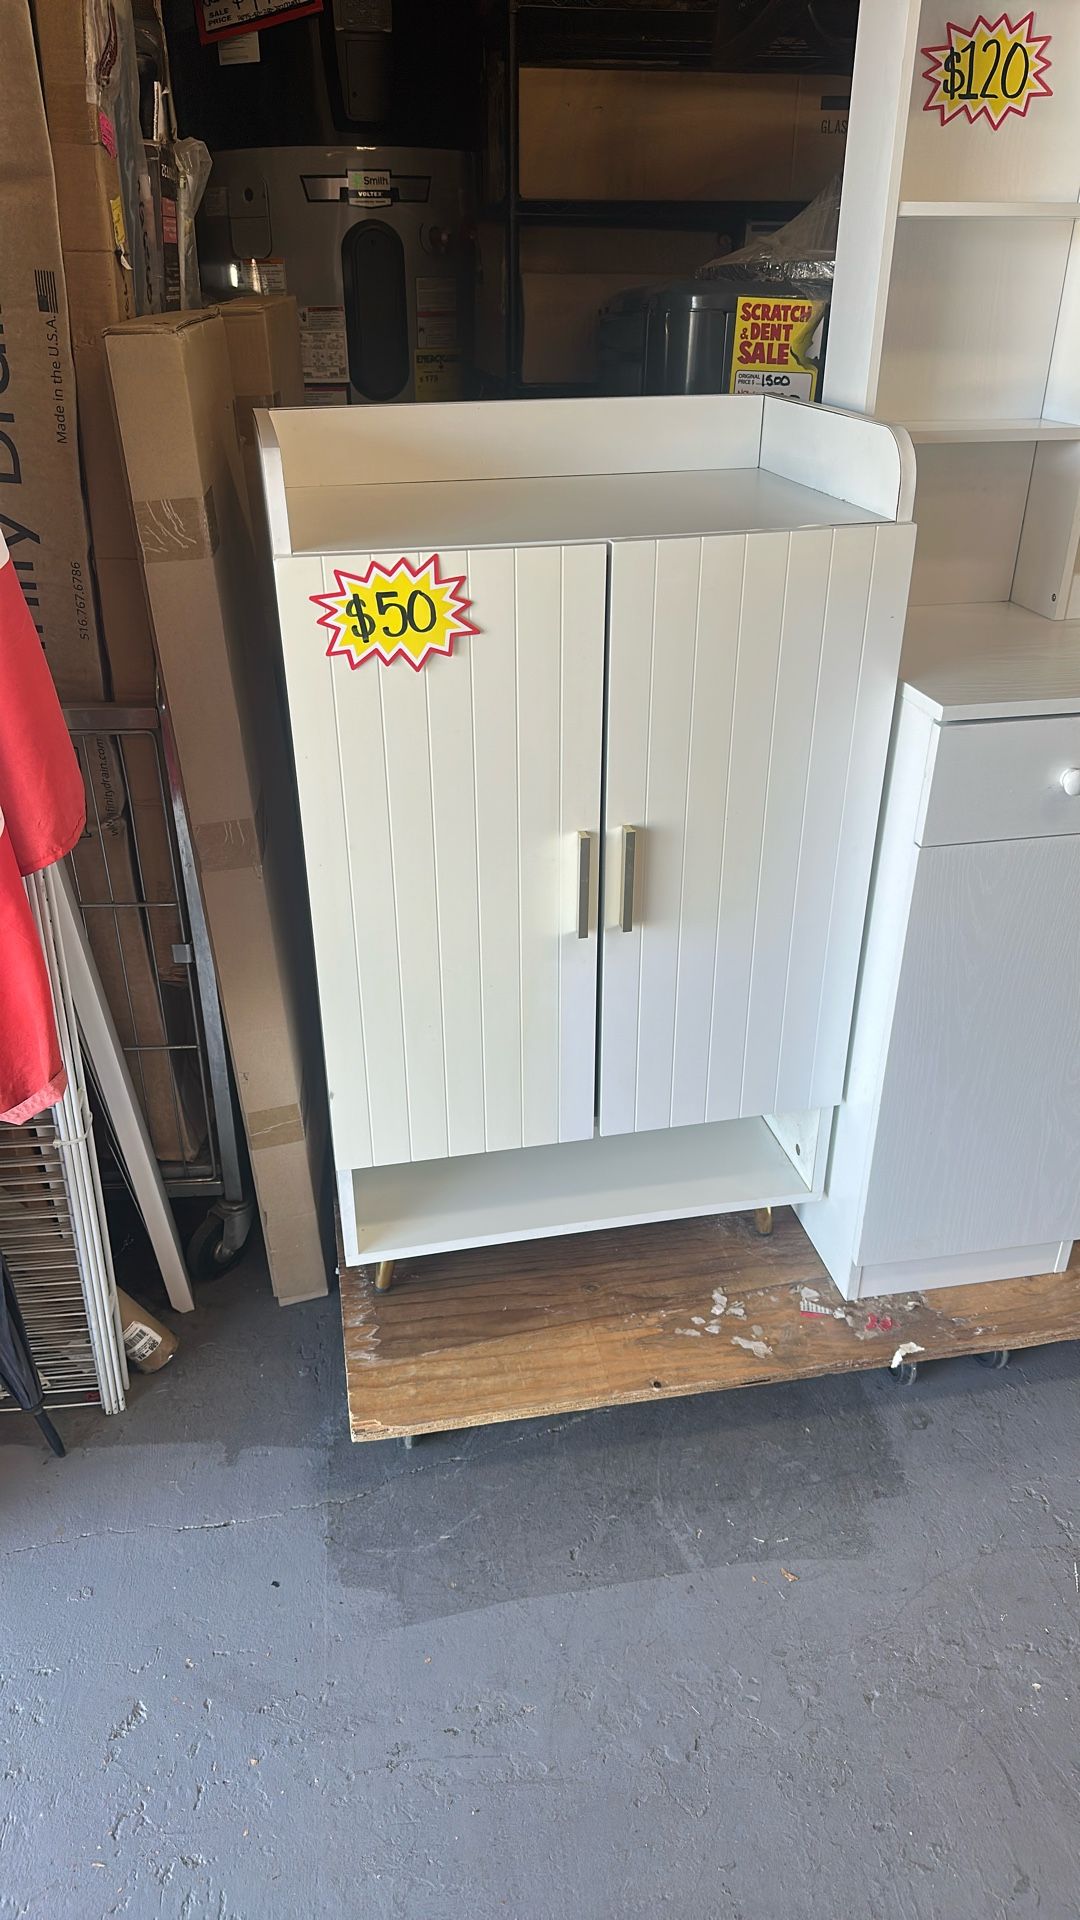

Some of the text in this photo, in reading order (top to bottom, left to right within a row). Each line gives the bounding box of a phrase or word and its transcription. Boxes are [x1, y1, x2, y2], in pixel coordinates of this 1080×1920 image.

[208, 15, 232, 26] PRICE
[209, 7, 229, 18] SALE
[943, 39, 1030, 100] $120
[363, 176, 388, 186] Smith
[740, 303, 813, 322] SCRATCH
[740, 322, 793, 342] & DENT
[737, 341, 790, 365] SALE
[46, 315, 67, 444] Made in the U.S.A.
[761, 374, 790, 387] 1500
[70, 561, 90, 641] 516.767.6786
[345, 590, 437, 643] $50
